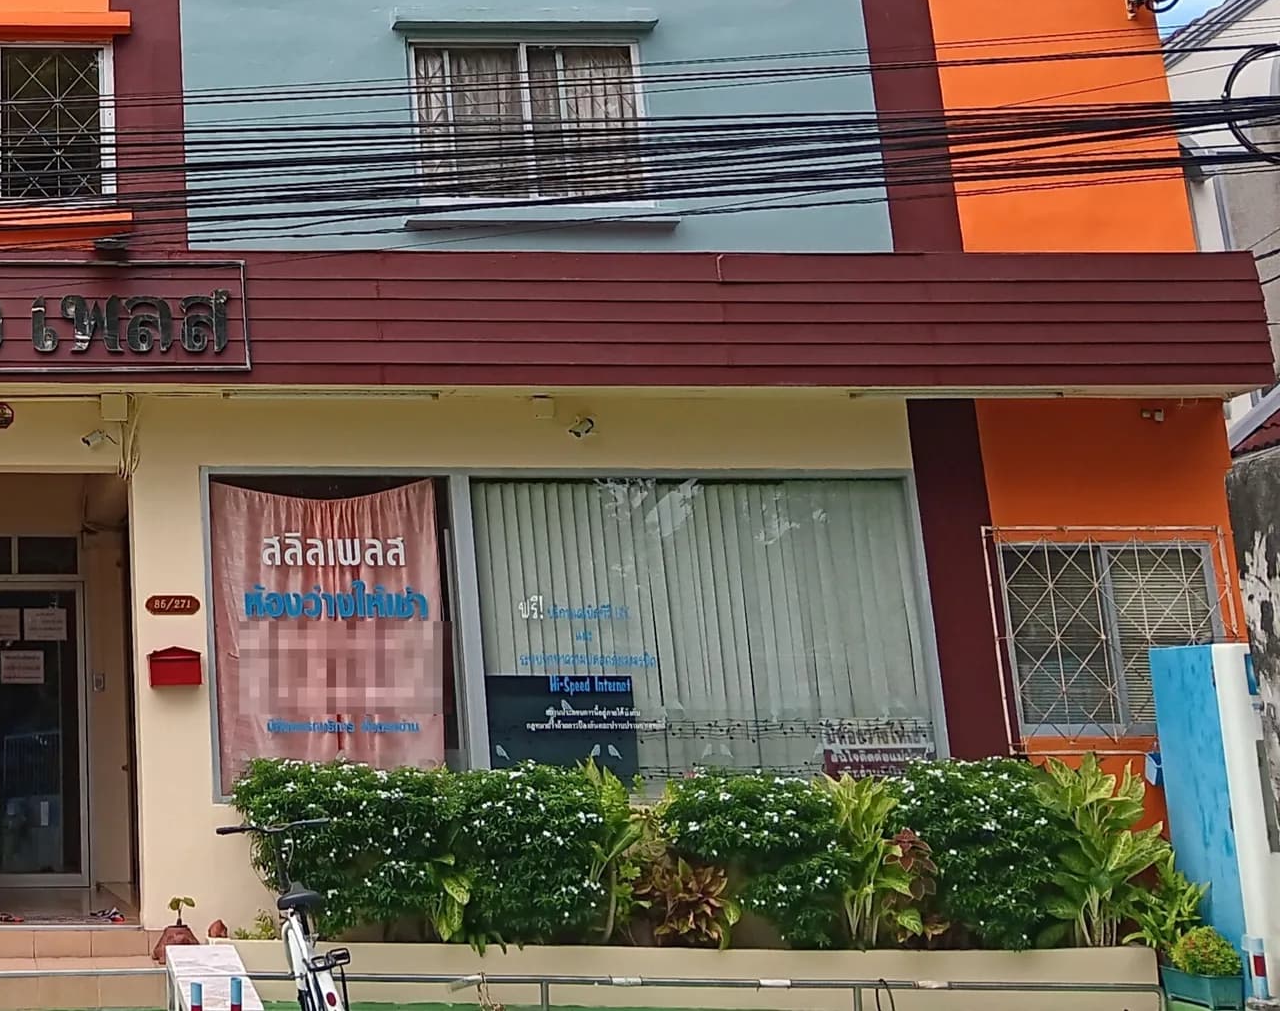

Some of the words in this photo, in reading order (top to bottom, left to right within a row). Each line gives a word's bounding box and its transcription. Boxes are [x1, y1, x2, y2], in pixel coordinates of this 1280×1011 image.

[31, 288, 230, 353] เพลส
[261, 532, 407, 566] สลิลเพลส
[154, 598, 191, 611] 85/271
[244, 580, 429, 620] ห้องว่างให้เช่า
[549, 674, 590, 695] Hi-Speed
[595, 676, 631, 693] Internet
